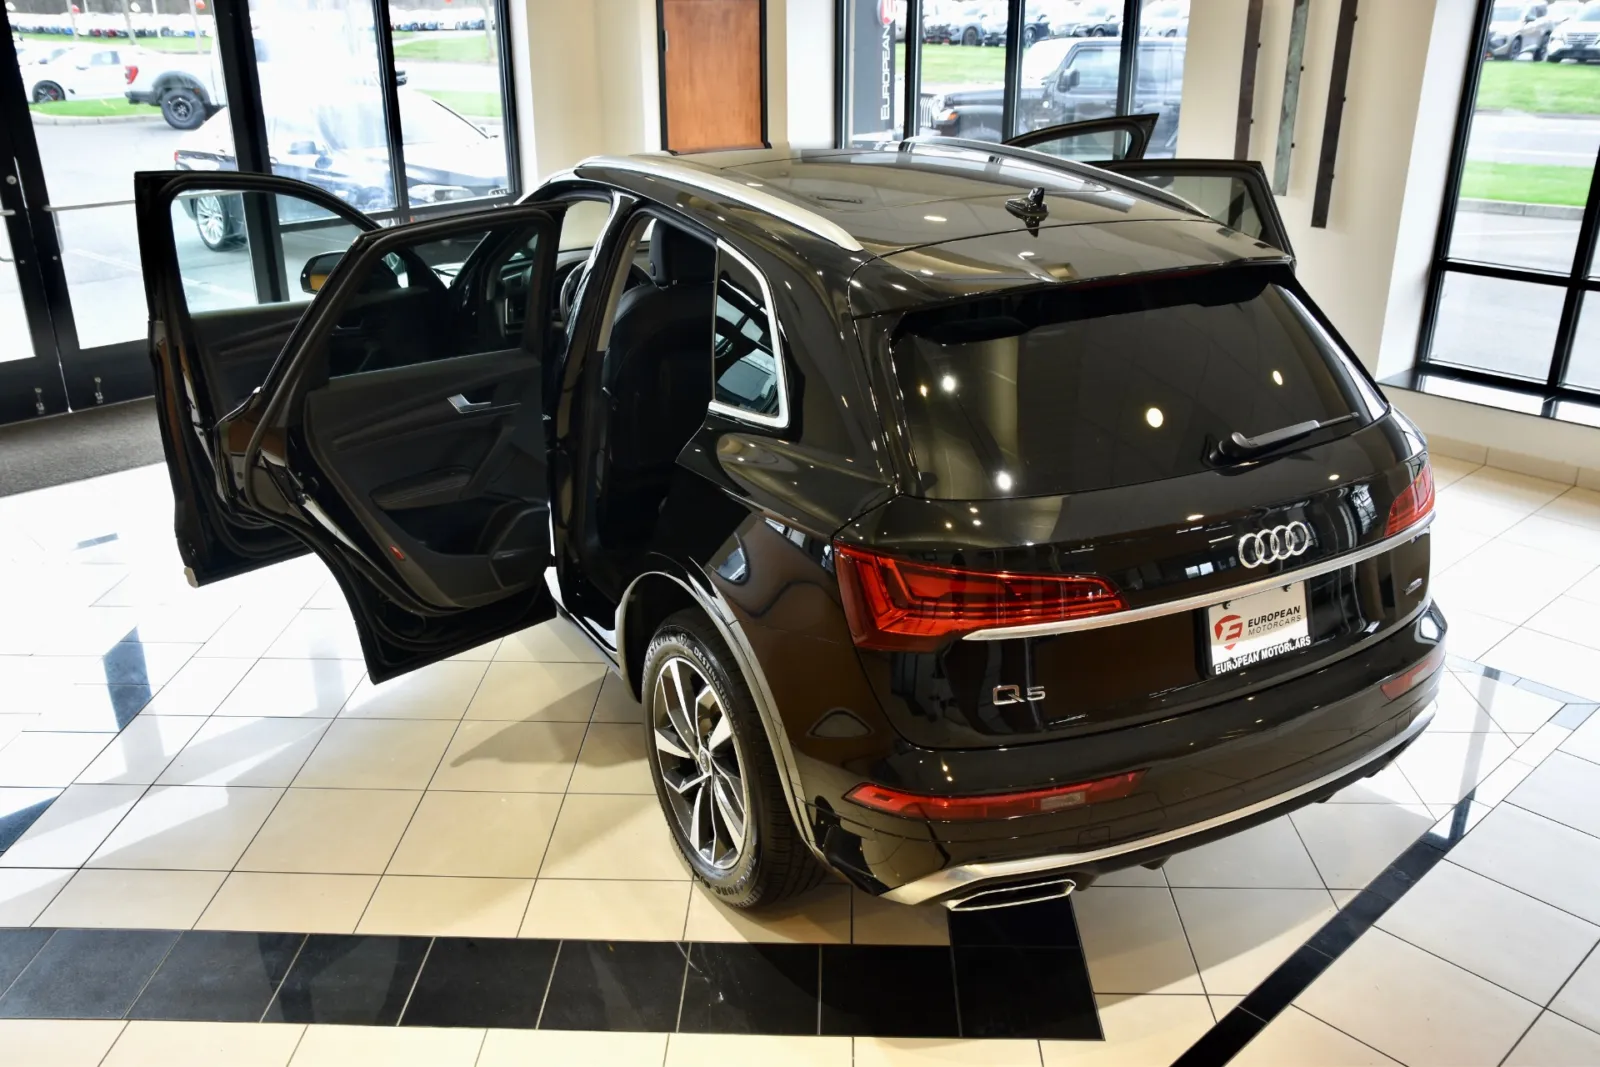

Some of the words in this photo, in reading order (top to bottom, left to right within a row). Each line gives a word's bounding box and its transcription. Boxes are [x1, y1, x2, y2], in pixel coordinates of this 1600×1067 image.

[881, 24, 891, 121] EUROPEAN
[1247, 605, 1301, 628] EUROPEAN
[1248, 614, 1302, 636] MOTORCARS
[1215, 652, 1260, 675] EUROPEAN
[1261, 635, 1311, 660] MOTORCARS
[693, 646, 735, 718] DESTINATION
[992, 684, 1046, 706] Q5
